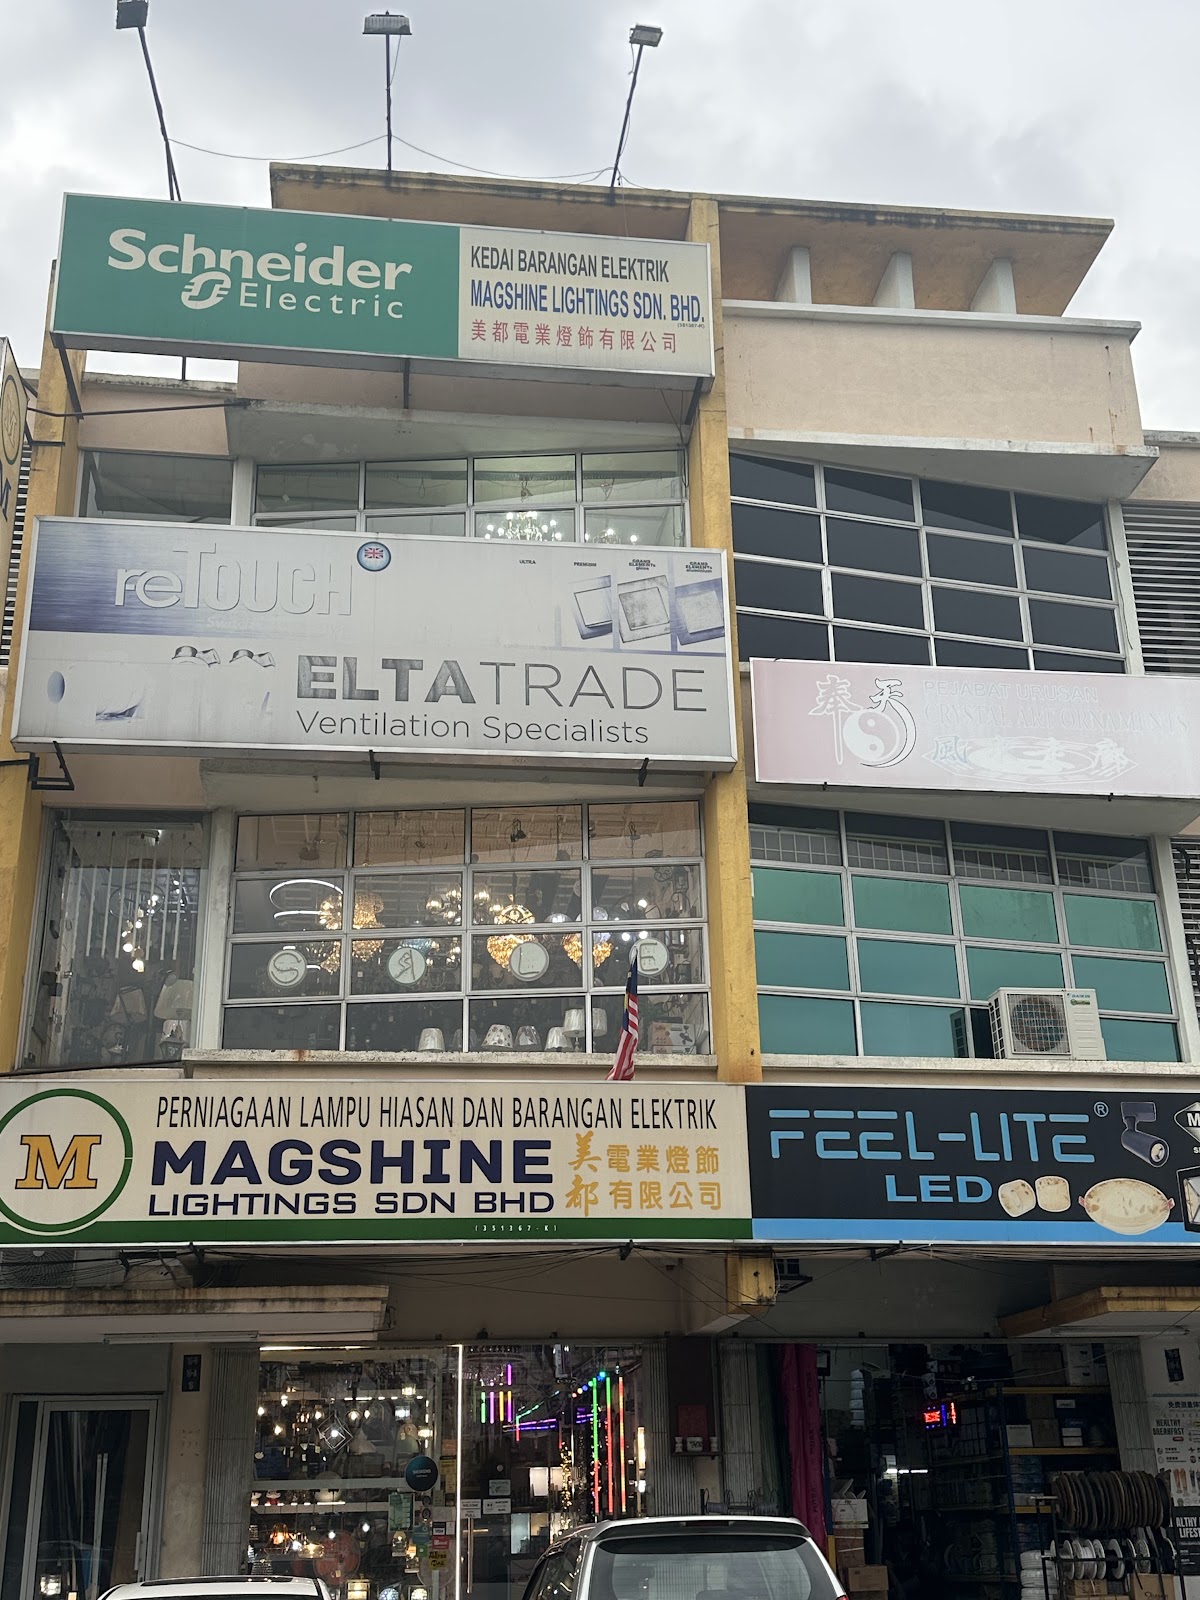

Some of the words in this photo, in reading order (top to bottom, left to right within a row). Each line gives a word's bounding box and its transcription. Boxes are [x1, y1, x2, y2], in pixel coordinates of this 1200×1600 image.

[107, 227, 413, 290] Schneider
[471, 245, 514, 271] KEDAI
[517, 249, 597, 278] BARANGAN
[601, 255, 669, 282] ELEKTRIK
[239, 281, 404, 319] Electric
[471, 279, 548, 312] MAGSHINE
[552, 285, 629, 318] LIGHTINGS
[633, 291, 666, 320] SDN.
[671, 294, 705, 323] BHD.
[471, 319, 677, 354] 美都電業燈飾有限公司
[923, 681, 1011, 701] PEJABAT
[1016, 684, 1098, 704] URUSAN
[296, 710, 471, 740] Ventilation
[482, 714, 651, 745] Specialists
[924, 704, 1011, 728] CRYSTAL
[1016, 707, 1056, 730] ART
[156, 1096, 290, 1128] PERNIAGAAN
[299, 1096, 370, 1128] LAMPU
[379, 1097, 454, 1128] HIASAN
[462, 1097, 504, 1128] DAN
[512, 1097, 623, 1129] BARANGAN
[630, 1098, 718, 1129] ELEKTRIK
[768, 1109, 1095, 1163] FEEL-LITE
[15, 1134, 102, 1190] M
[150, 1139, 553, 1186] MAGSHINE
[606, 1143, 720, 1175] 電業燈飾
[149, 1193, 358, 1218] LIGHTINGS
[374, 1193, 457, 1217] SDN
[473, 1192, 555, 1216] BHD
[610, 1180, 723, 1211] 有限公司
[884, 1174, 993, 1204] LED
